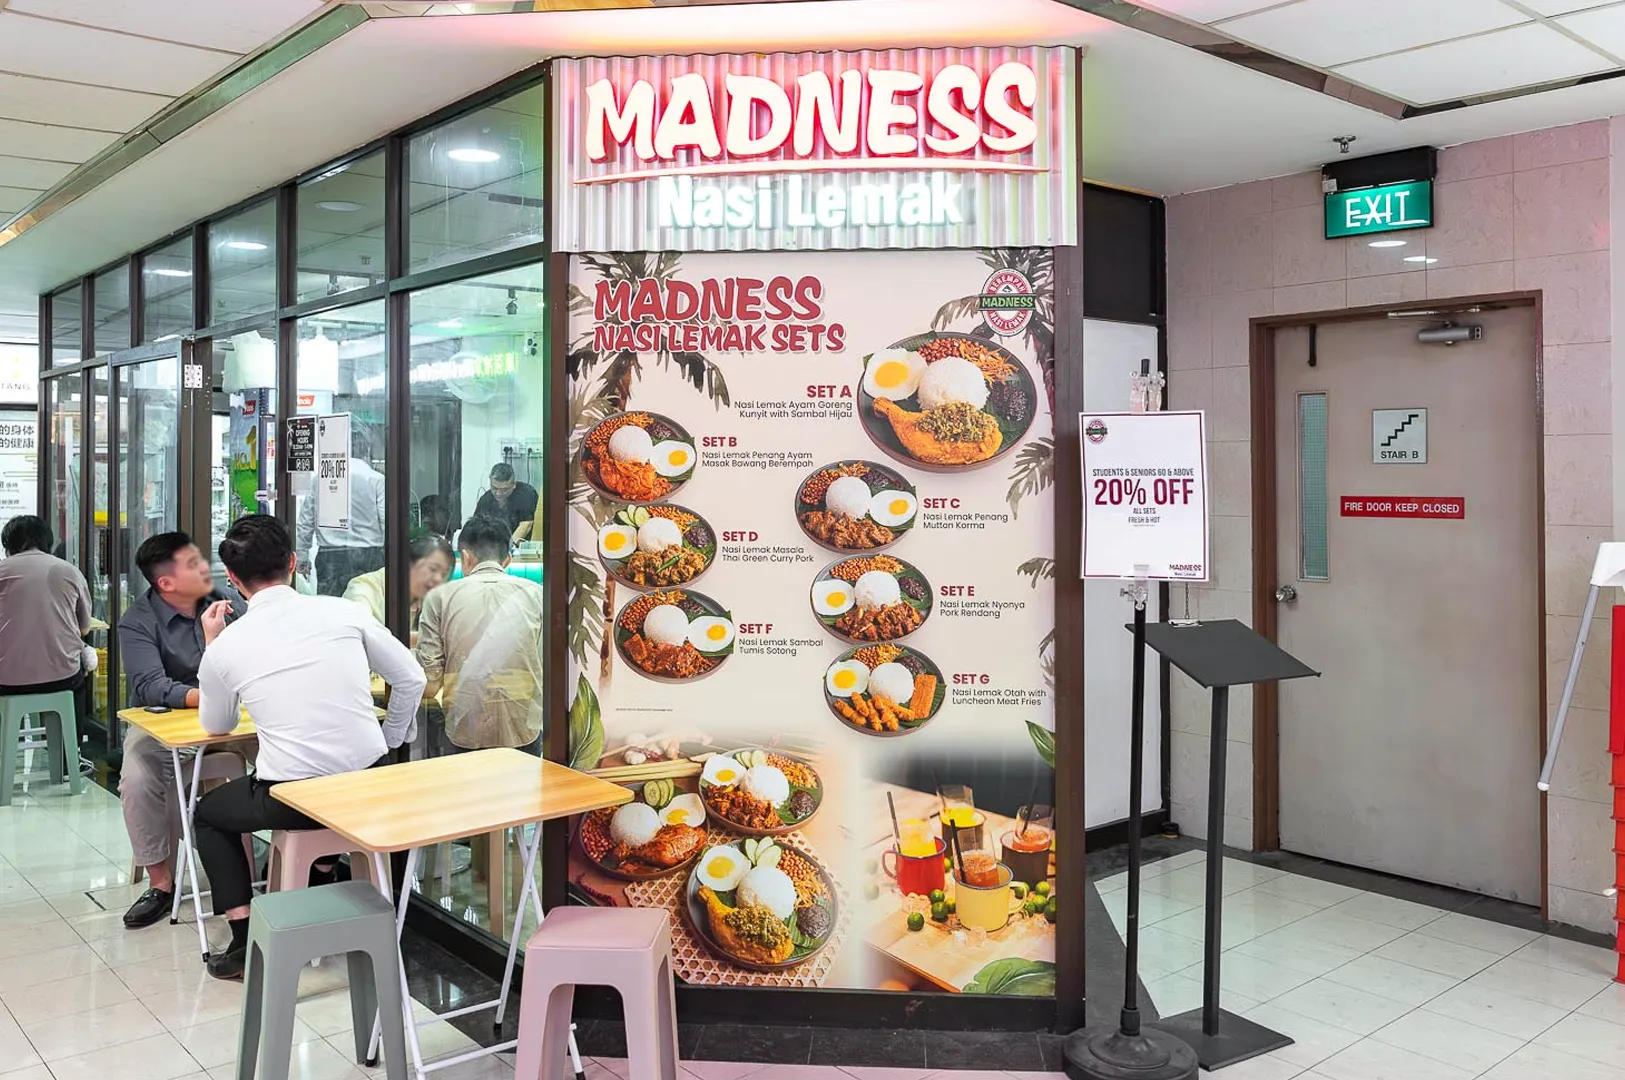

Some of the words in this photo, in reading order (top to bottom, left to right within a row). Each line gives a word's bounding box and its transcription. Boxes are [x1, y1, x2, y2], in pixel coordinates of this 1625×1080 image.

[585, 61, 1038, 163] MADNESS
[658, 175, 772, 228] Nasi
[789, 171, 963, 228] Lemak
[1346, 191, 1410, 228] EXIT
[594, 275, 823, 321] MADNESS
[982, 297, 1033, 307] MADNESS
[989, 312, 1003, 328] NASI
[1004, 311, 1026, 330] LEMAK
[594, 324, 669, 353] NASI
[670, 323, 767, 352] LEMAK
[772, 323, 846, 352] SETS
[807, 385, 836, 398] SET
[840, 385, 852, 398] A
[734, 401, 754, 409] Nasi
[757, 401, 786, 409] Lemak
[789, 401, 815, 411] Ayam
[818, 401, 852, 411] Goreng
[740, 410, 767, 420] Kunyit
[770, 410, 788, 418] with
[791, 410, 826, 418] Sambal
[829, 410, 852, 420] Hijau
[702, 436, 726, 447] SET
[729, 436, 737, 447] B
[702, 451, 721, 459] Nasi
[723, 451, 751, 459] Lemak
[752, 451, 785, 460] Penang
[787, 451, 812, 460] Ayam
[1381, 450, 1408, 460] STAIR
[1412, 450, 1419, 459] B
[336, 459, 346, 478] OFF
[732, 460, 766, 469] Bawang
[769, 460, 813, 469] Berempah
[1093, 468, 1124, 477] STUDENTS
[1130, 468, 1157, 477] SENIORS
[1173, 468, 1194, 476] ABOVE
[1094, 479, 1147, 505] 20%
[1153, 479, 1194, 504] OFF
[923, 498, 947, 509] SET
[950, 498, 960, 509] C
[1344, 501, 1363, 511] FIRE
[1366, 501, 1392, 512] DOOR
[1395, 502, 1419, 512] KEEP
[1422, 503, 1459, 513] CLOSED
[944, 513, 972, 521] Lemak
[975, 513, 1009, 523] Penang
[722, 531, 746, 542] SET
[748, 531, 758, 541] D
[722, 554, 740, 562] Thai
[742, 554, 768, 562] Green
[770, 555, 793, 564] Curry
[940, 586, 964, 596] SET
[967, 586, 975, 596] E
[940, 600, 959, 608] Nasi
[961, 600, 990, 608] Lemak
[992, 601, 1025, 610] Nyonya
[961, 609, 1001, 619] Rendang
[739, 623, 762, 634] SET
[765, 624, 773, 634] F
[739, 638, 757, 646] Nasi
[759, 638, 788, 646] Lemak
[789, 638, 824, 647] Sambal
[766, 647, 797, 656] Sotong
[952, 674, 976, 685] SET
[979, 674, 990, 684] G
[952, 688, 971, 696] Nasi
[973, 688, 1002, 696] Lemak
[1004, 688, 1026, 697] Otah
[1027, 689, 1046, 697] with
[952, 697, 995, 705] Luncheon
[1021, 698, 1042, 706] Fries
